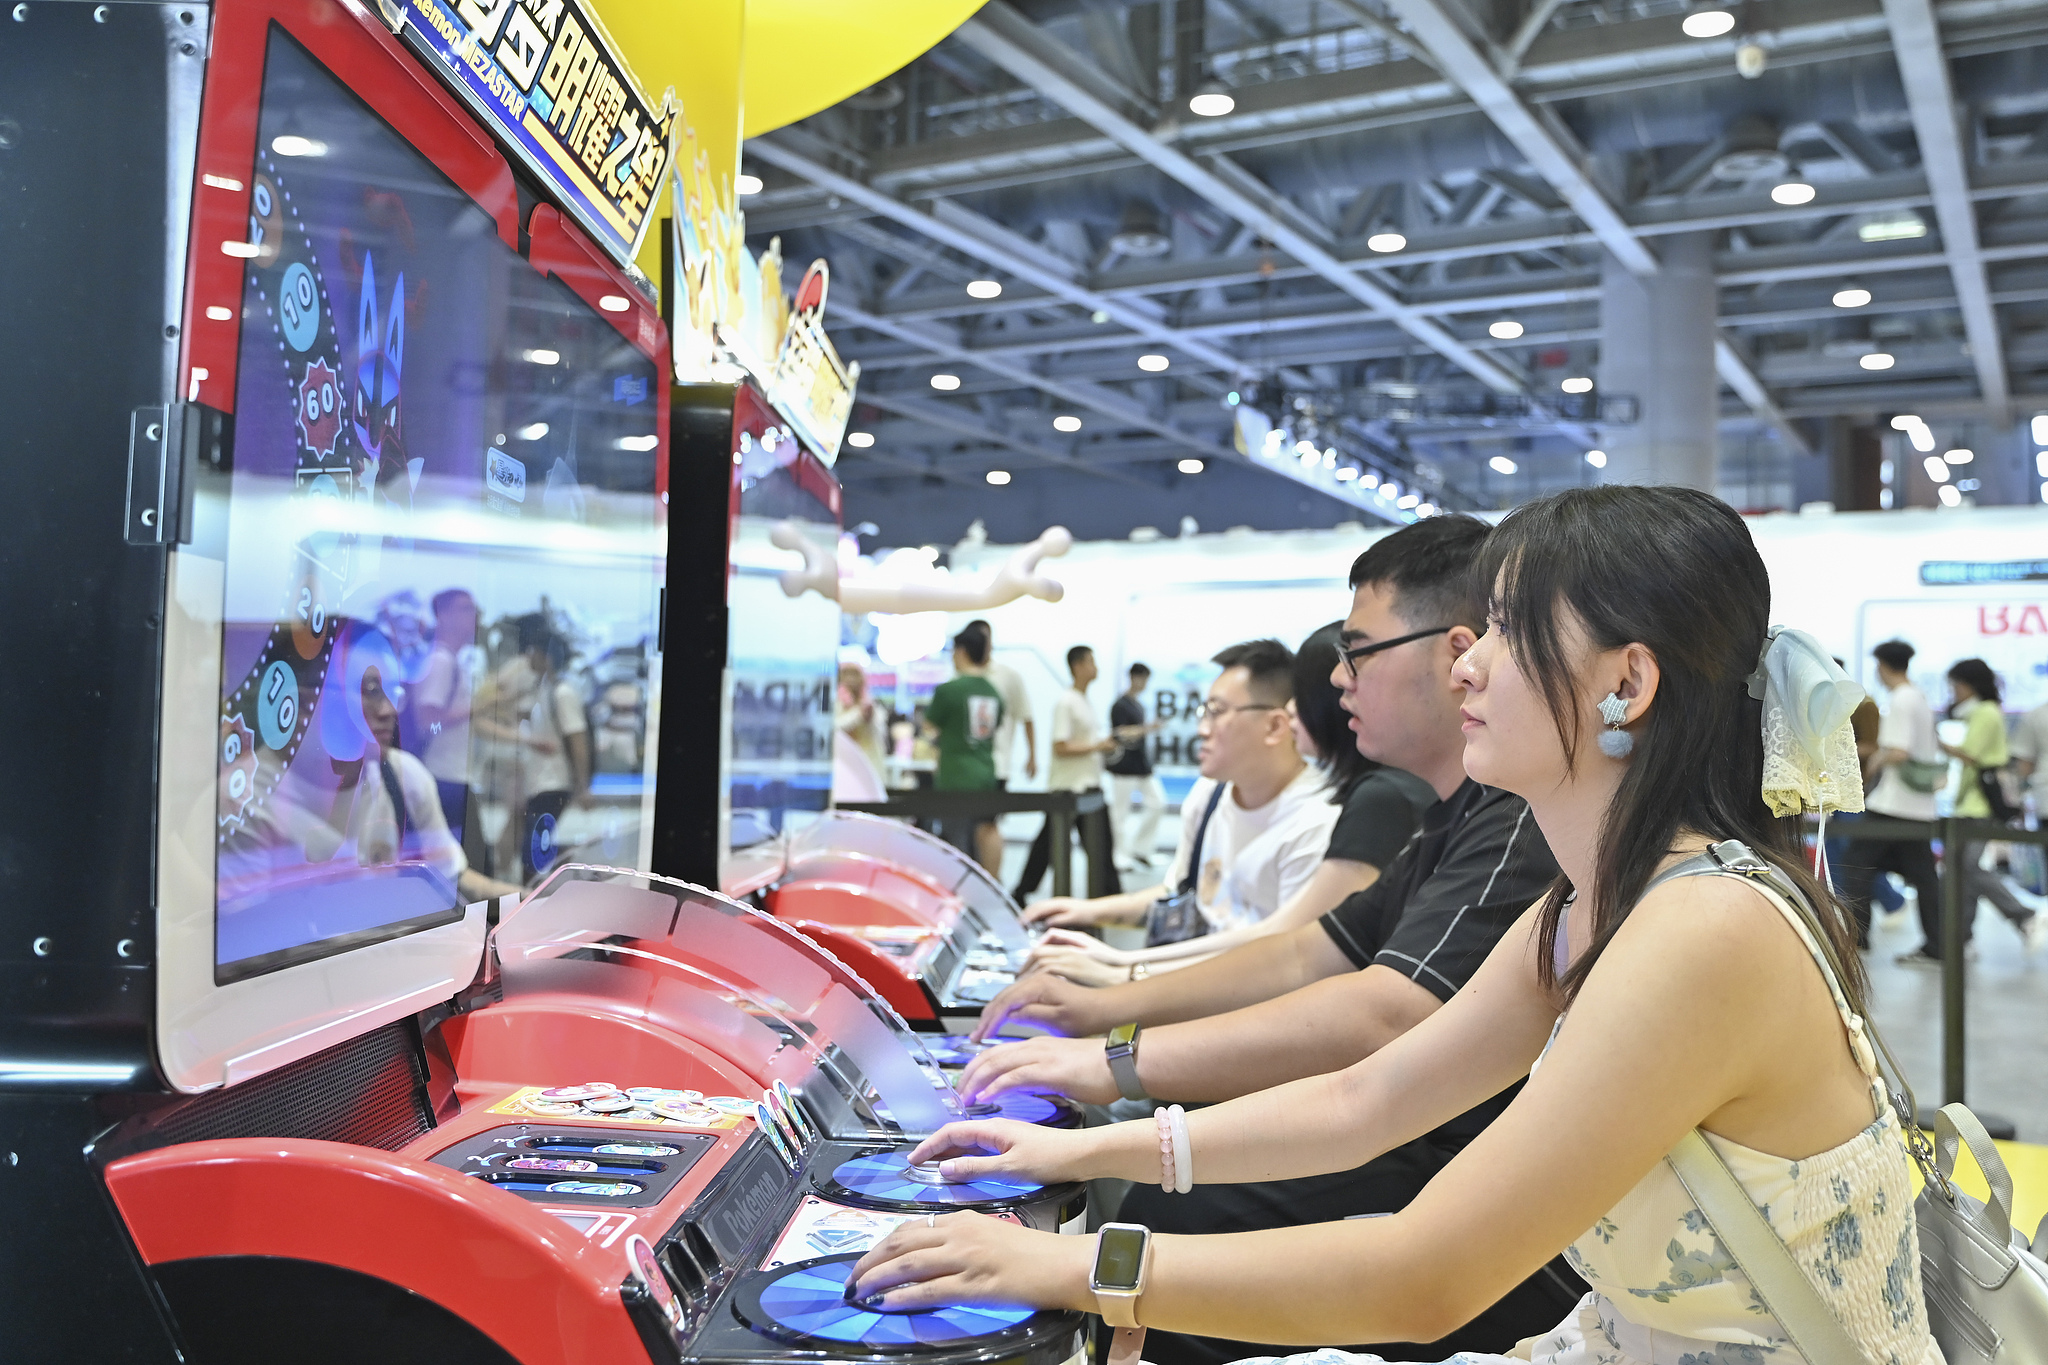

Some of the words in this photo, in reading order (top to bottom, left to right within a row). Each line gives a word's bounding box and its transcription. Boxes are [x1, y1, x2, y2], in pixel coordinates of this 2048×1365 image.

[457, 35, 526, 121] MEZASTAR
[284, 275, 312, 325] 10
[306, 382, 334, 421] 60
[297, 587, 325, 634] 20
[268, 670, 295, 729] 10
[224, 732, 246, 799] 60
